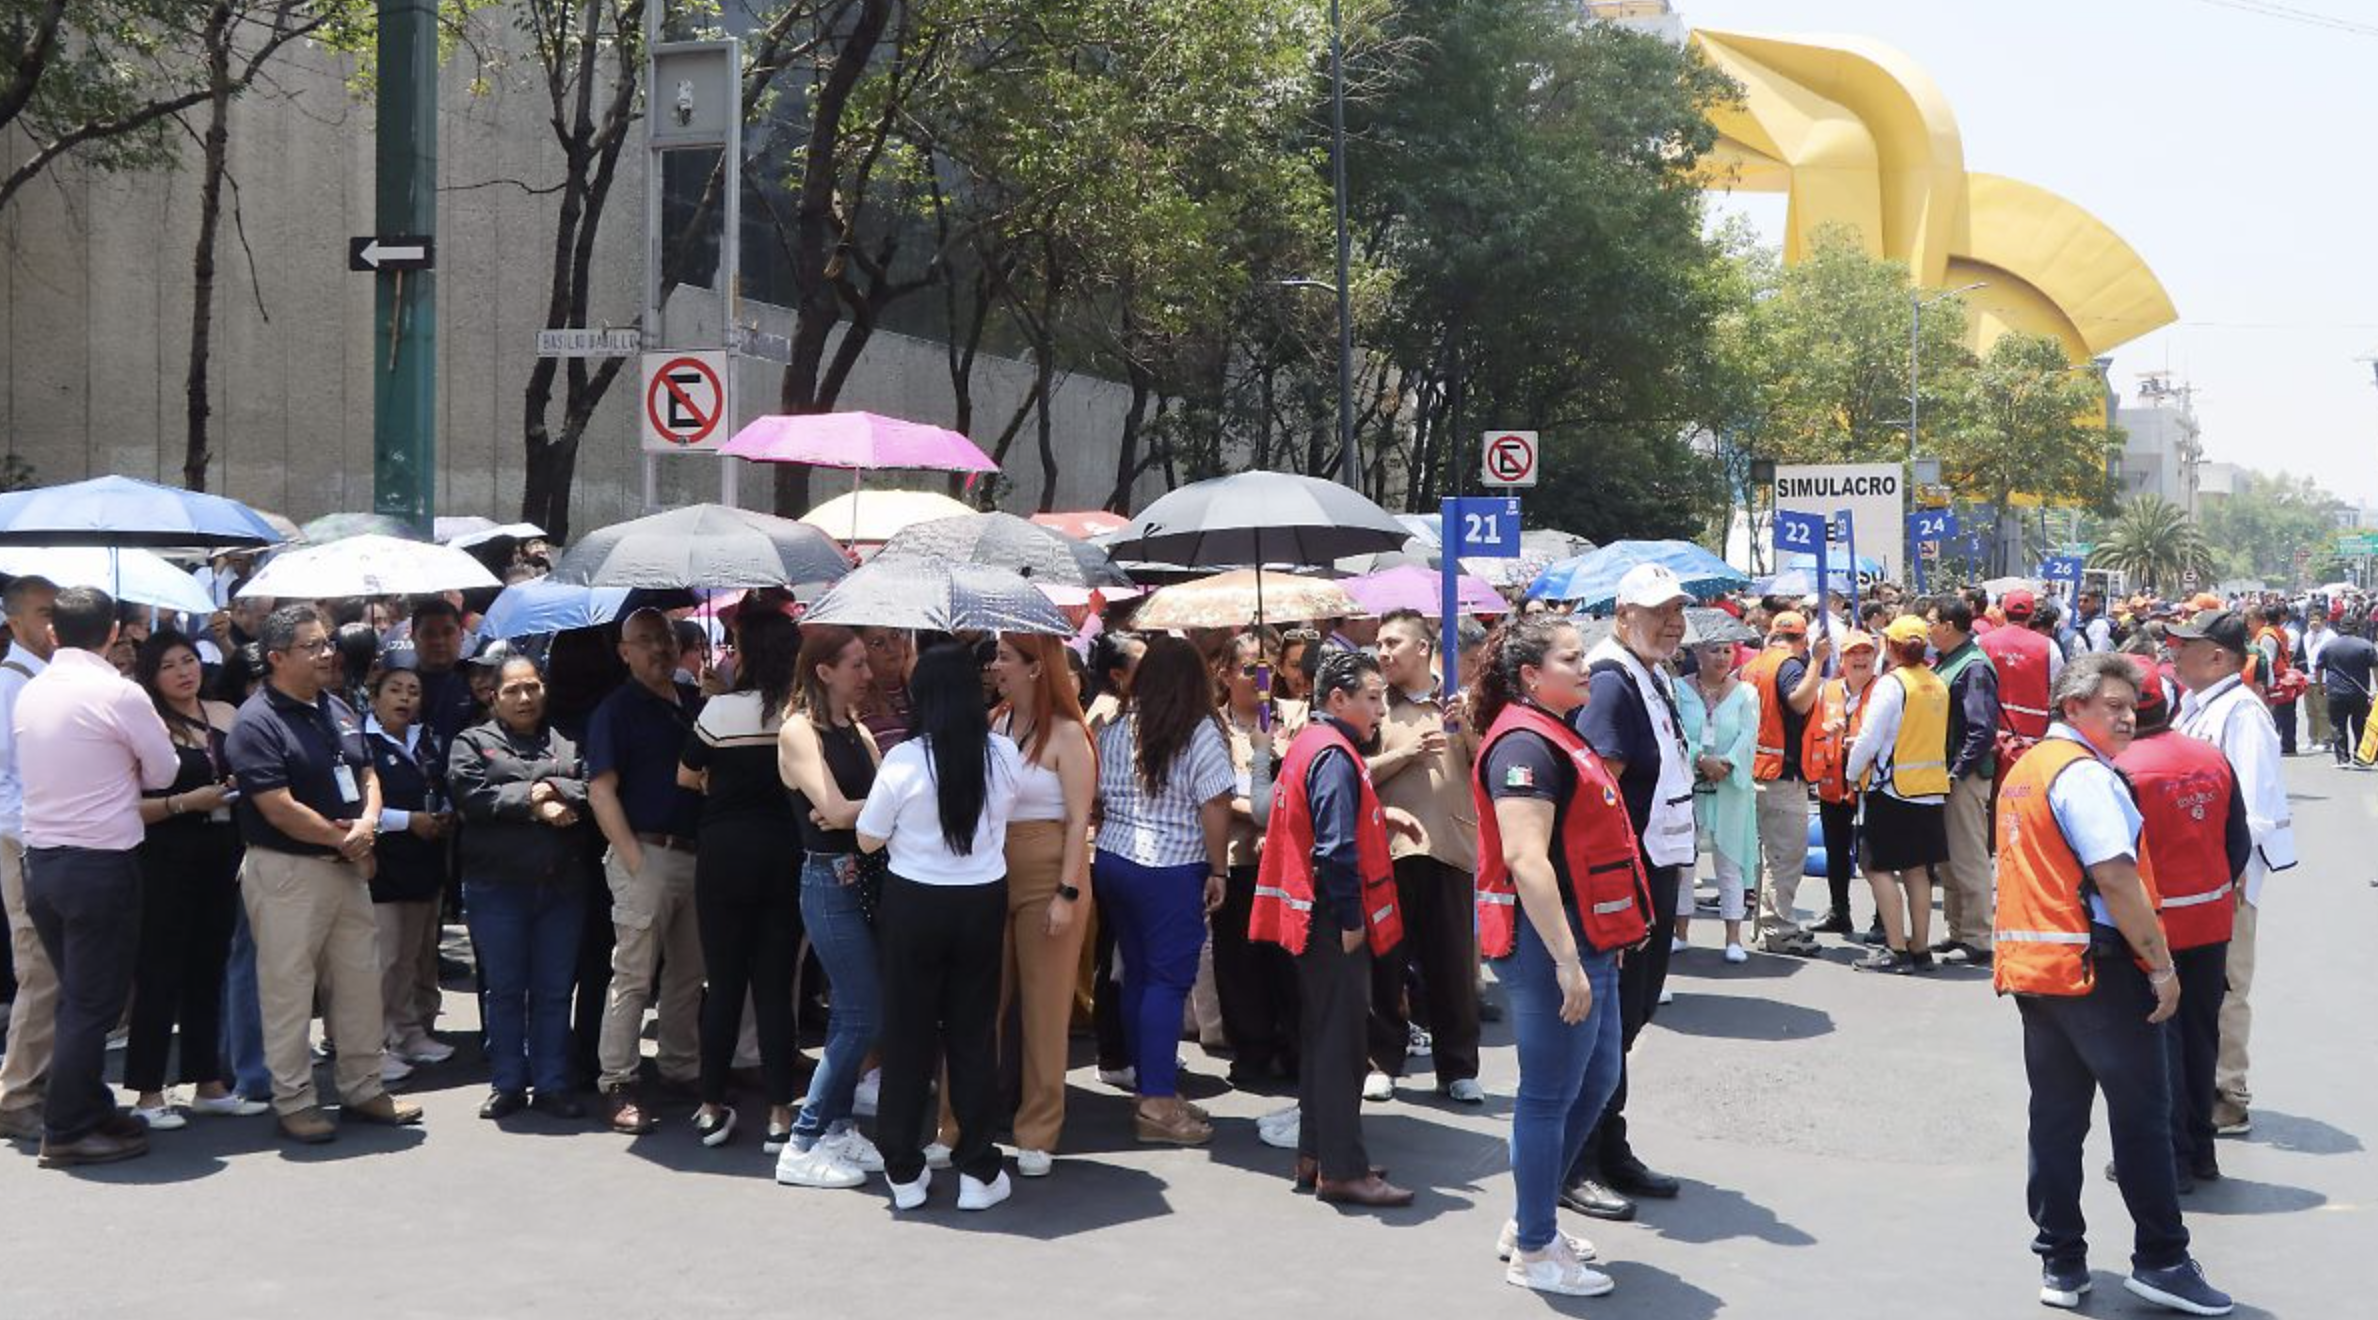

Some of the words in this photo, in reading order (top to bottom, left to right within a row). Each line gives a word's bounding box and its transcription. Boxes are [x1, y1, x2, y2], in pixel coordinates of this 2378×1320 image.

[1777, 476, 1896, 498] SIMULACRO
[1465, 513, 1501, 544] 21
[1785, 521, 1811, 544] 22
[1920, 517, 1945, 535] 24
[2053, 562, 2073, 576] 26
